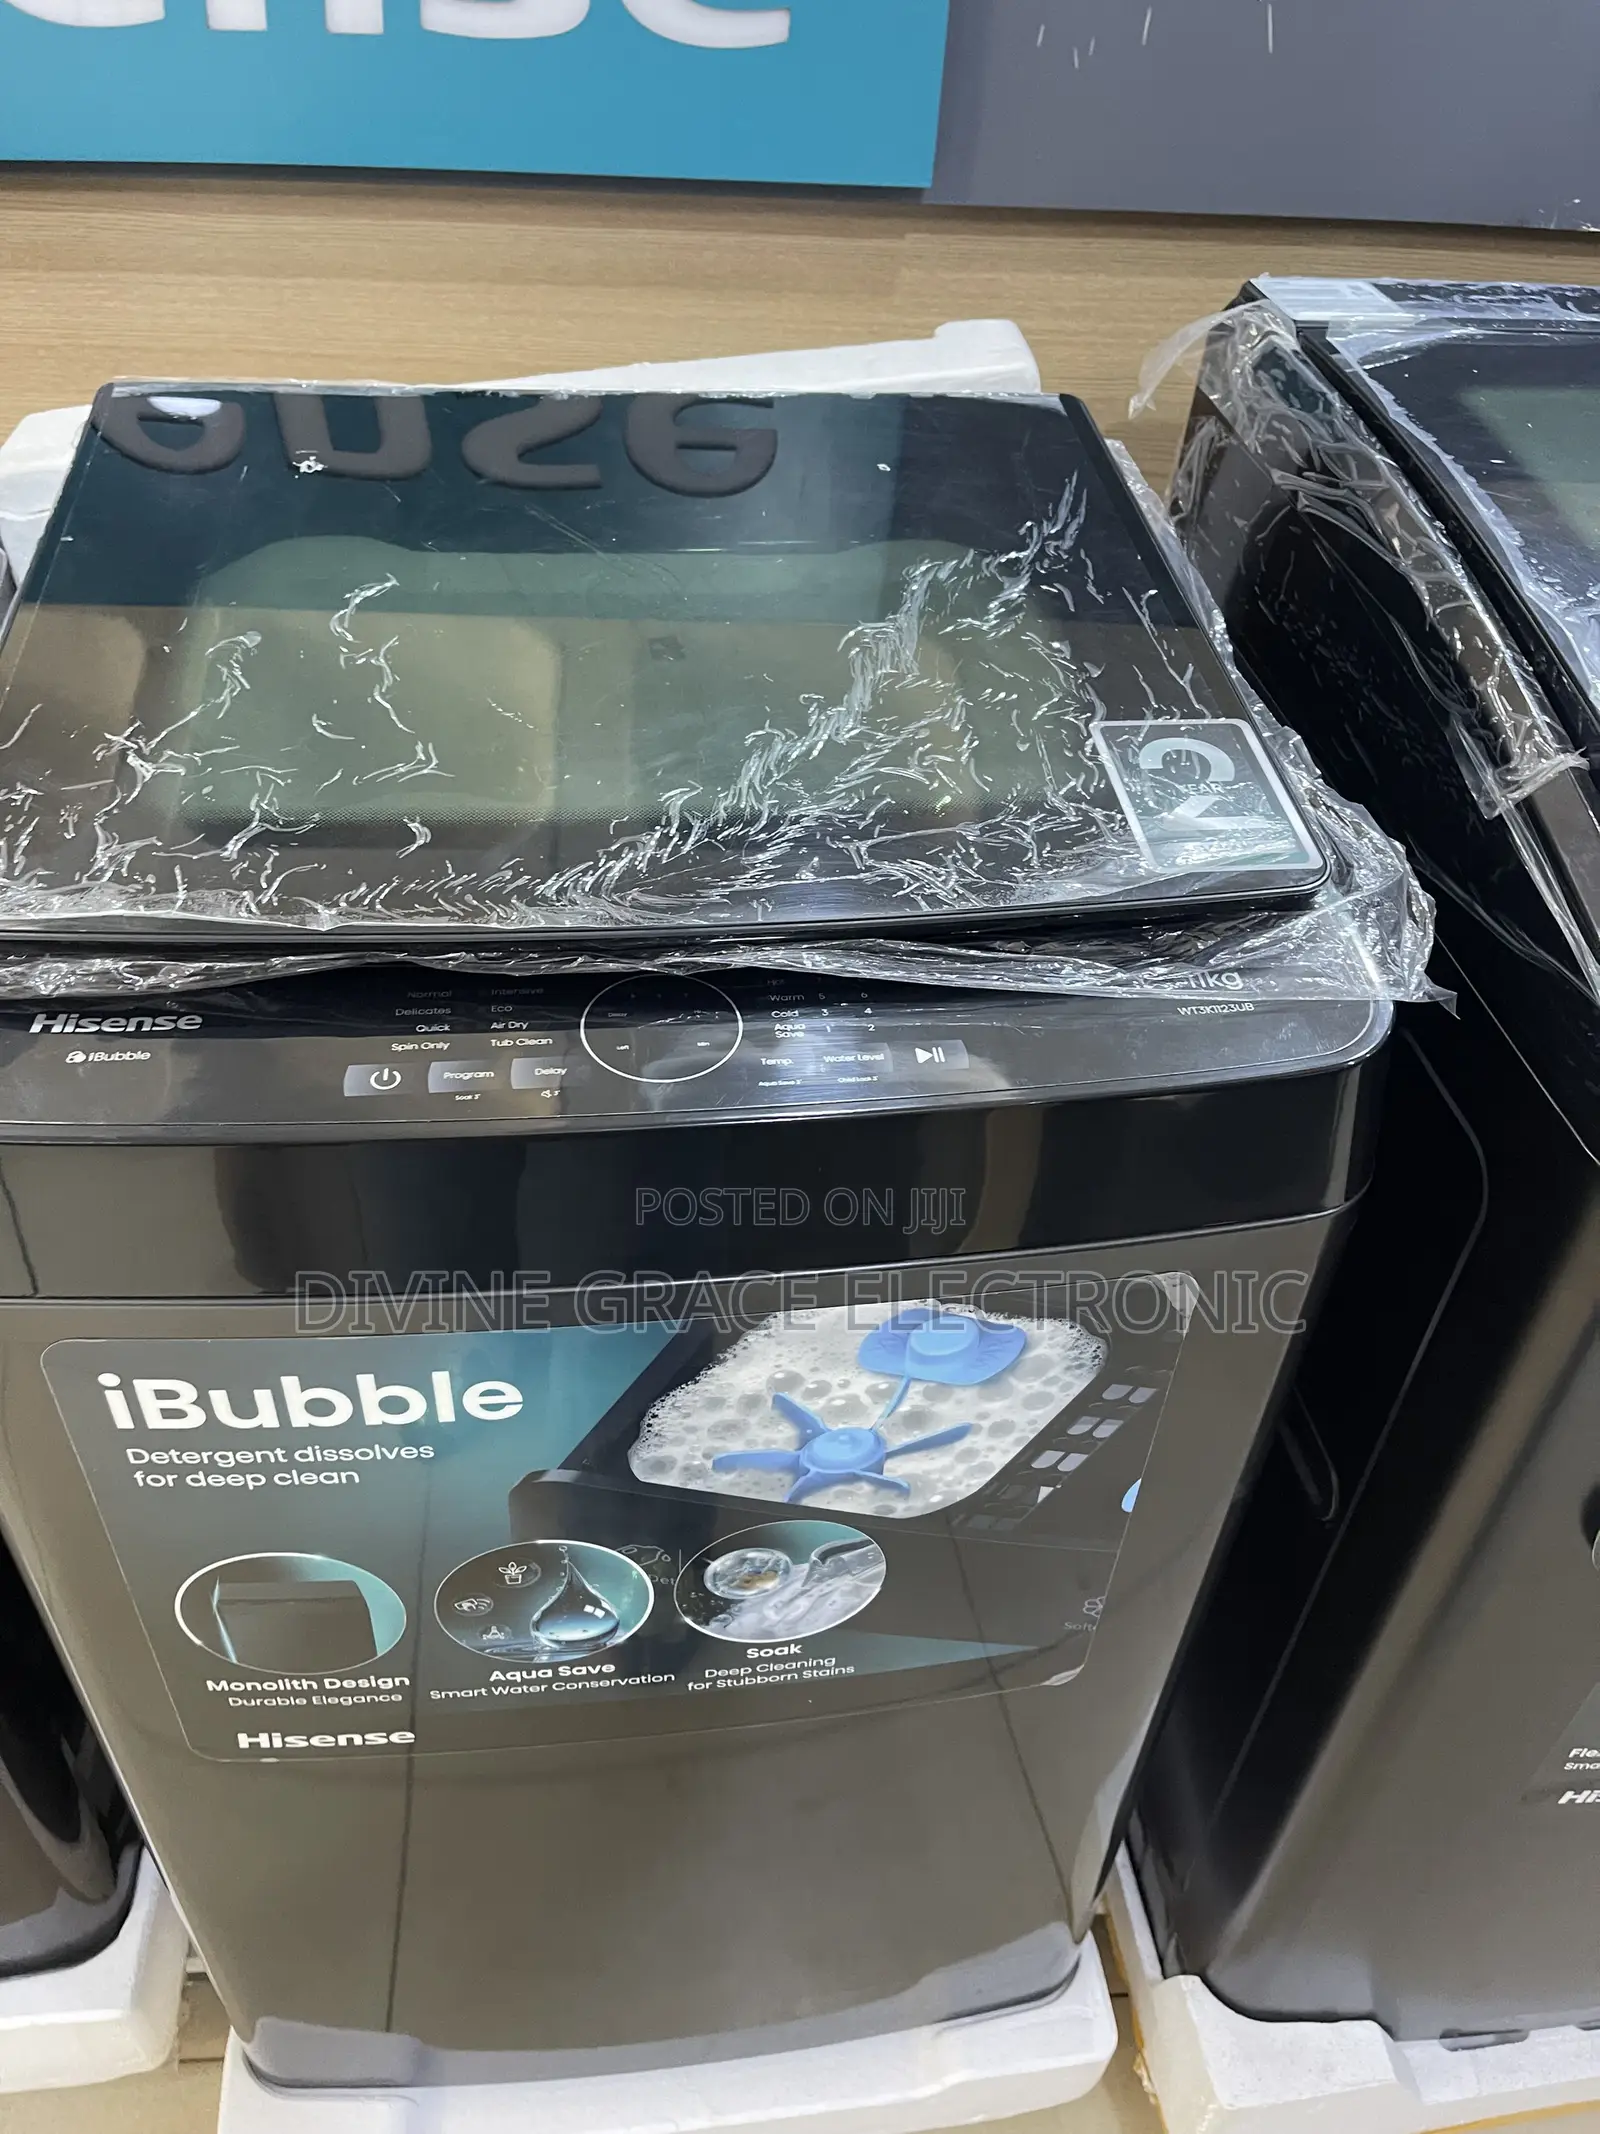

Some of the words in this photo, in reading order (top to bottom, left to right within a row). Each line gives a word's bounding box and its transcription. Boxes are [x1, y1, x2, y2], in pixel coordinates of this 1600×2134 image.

[408, 990, 452, 999] Normal
[491, 987, 544, 996] Intensive
[395, 1007, 452, 1017] Delicates
[771, 1009, 799, 1018] Cold
[28, 1013, 203, 1034] Hisense
[415, 1023, 451, 1033] Quick
[490, 1021, 505, 1030] Air
[507, 1021, 529, 1031] Dry
[774, 1023, 807, 1032] Aqua
[775, 1030, 805, 1039] Save
[391, 1042, 419, 1052] Spin
[420, 1041, 451, 1051] Only
[490, 1038, 512, 1048] Tub
[515, 1036, 554, 1047] Clean
[88, 1051, 151, 1062] iBubble
[760, 1057, 795, 1066] Temp.
[822, 1054, 855, 1063] Water
[857, 1052, 885, 1062] Level
[443, 1070, 495, 1081] Program
[534, 1066, 568, 1077] Delay
[97, 1370, 524, 1430] iBubble
[125, 1446, 288, 1468] Detergent
[293, 1442, 435, 1463] dissolves
[133, 1469, 178, 1488] for
[184, 1468, 267, 1490] deep
[272, 1467, 360, 1486] clean
[746, 1643, 802, 1659] Soak
[489, 1666, 552, 1683] Aqua
[558, 1662, 616, 1676] Save
[704, 1666, 752, 1680] Deep
[755, 1655, 836, 1672] Cleaning
[206, 1678, 318, 1692] Monolith
[323, 1675, 411, 1691] Design
[687, 1680, 714, 1691] for
[716, 1673, 798, 1689] Stubborn
[802, 1665, 856, 1679] Stains
[430, 1687, 488, 1700] Smart
[492, 1683, 548, 1696] Water
[553, 1673, 675, 1692] Conservation
[228, 1696, 307, 1707] Durable
[312, 1693, 403, 1706] Elegance
[237, 1730, 415, 1749] Hisense
